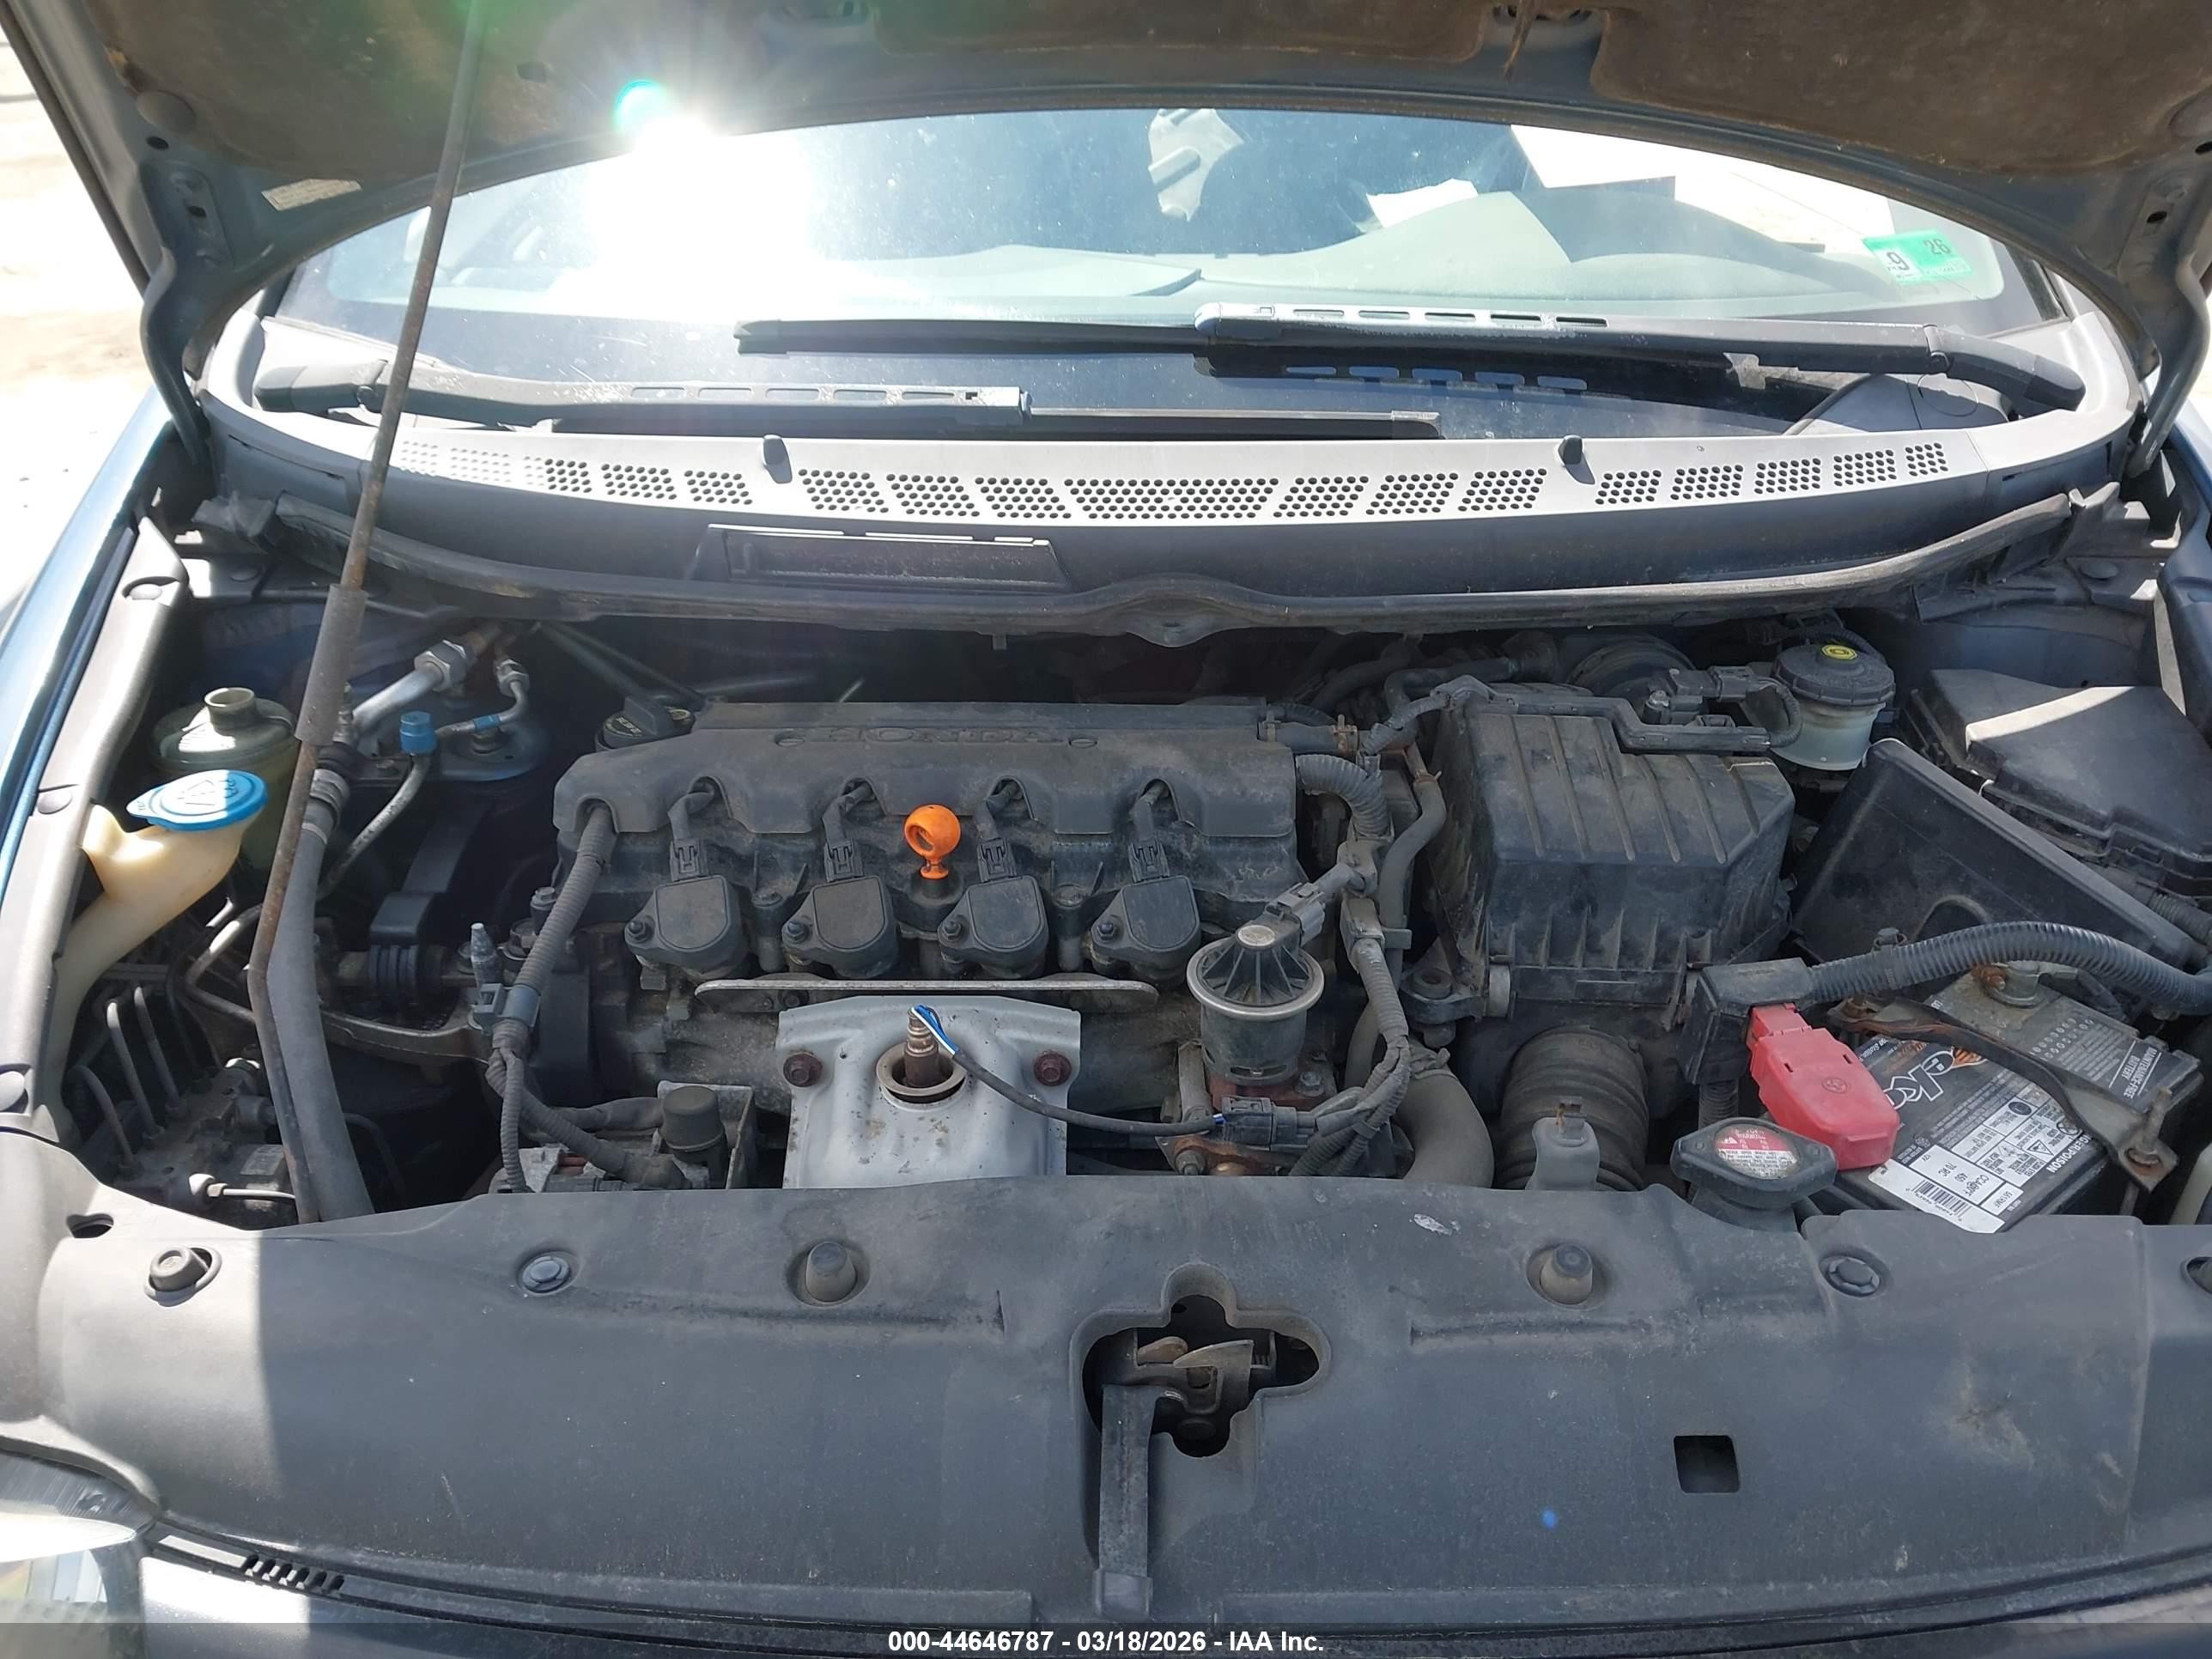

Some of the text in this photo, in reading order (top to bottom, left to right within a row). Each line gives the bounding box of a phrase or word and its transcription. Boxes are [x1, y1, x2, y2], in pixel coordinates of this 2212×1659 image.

[1887, 252, 1910, 271] 9
[2121, 1054, 2141, 1081] BATTERY
[2123, 1047, 2158, 1099] MAINTENANCE-FREE
